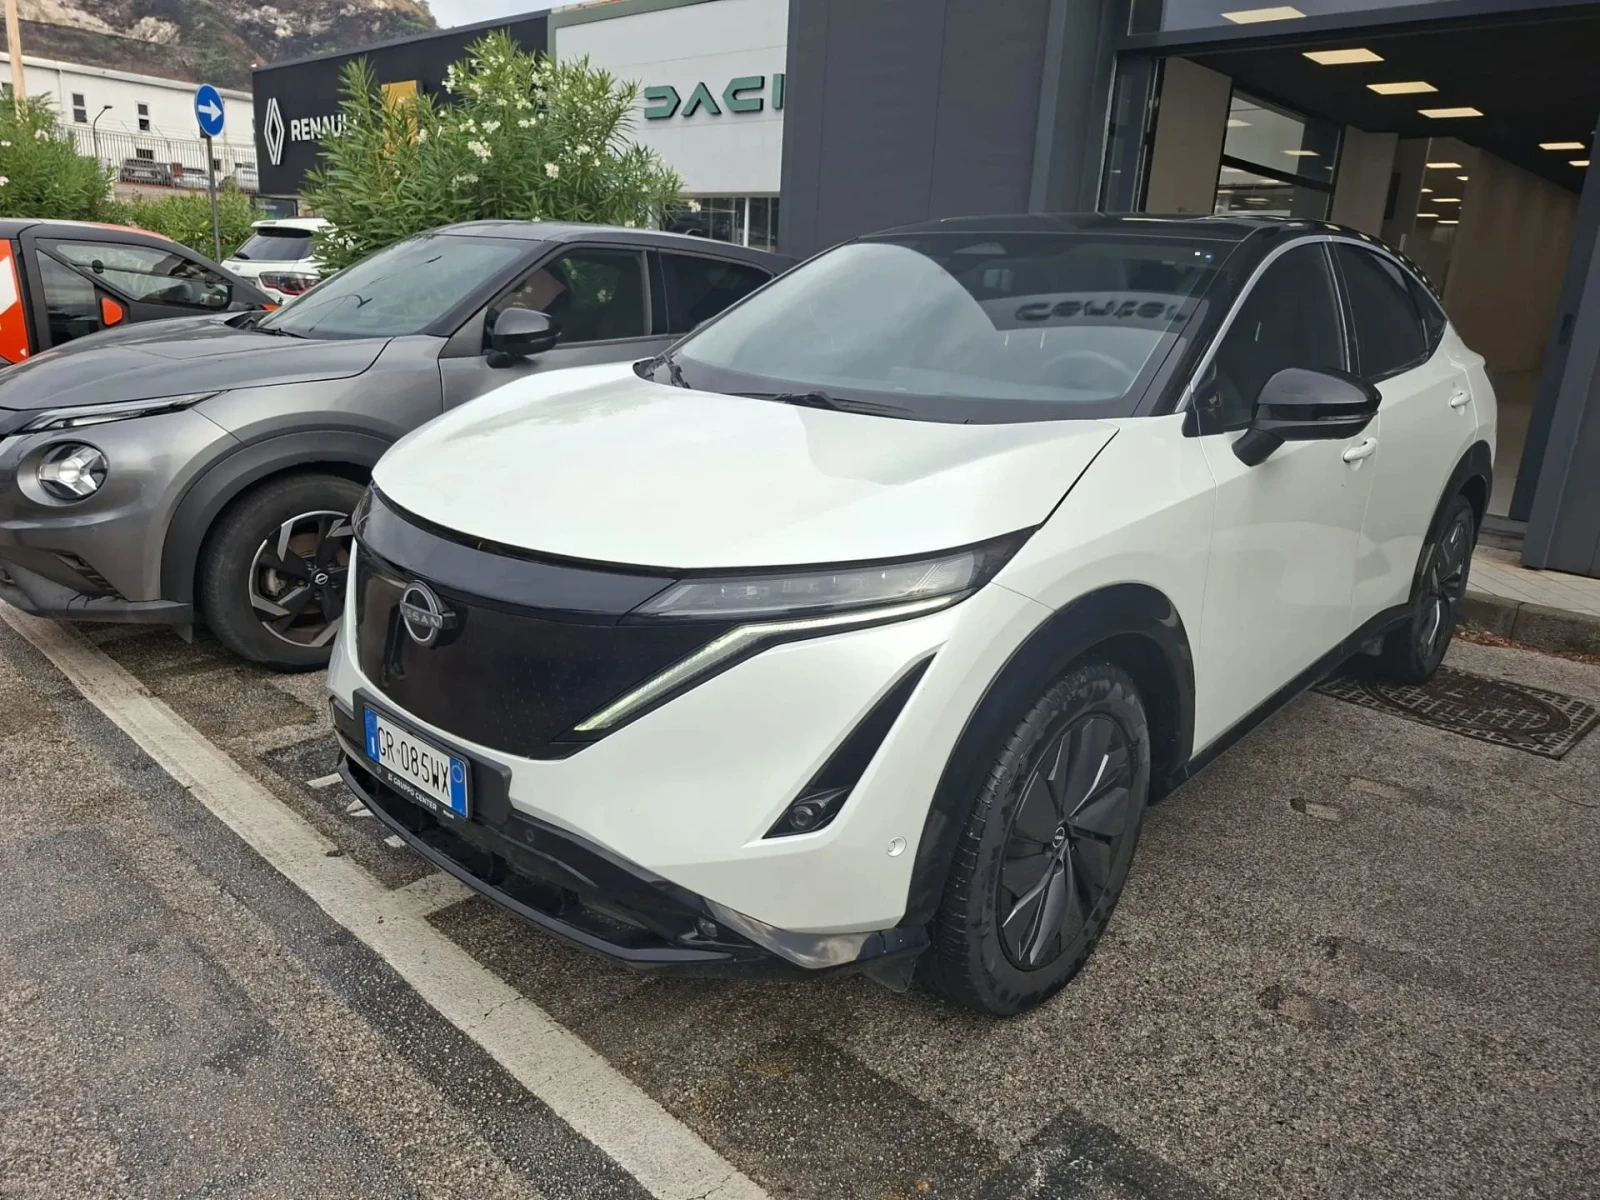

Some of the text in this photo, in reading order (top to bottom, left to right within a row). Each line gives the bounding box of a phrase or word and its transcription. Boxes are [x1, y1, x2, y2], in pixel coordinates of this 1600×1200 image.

[401, 604, 440, 627] SSAN
[393, 777, 438, 812] GRUPPO CENTER
